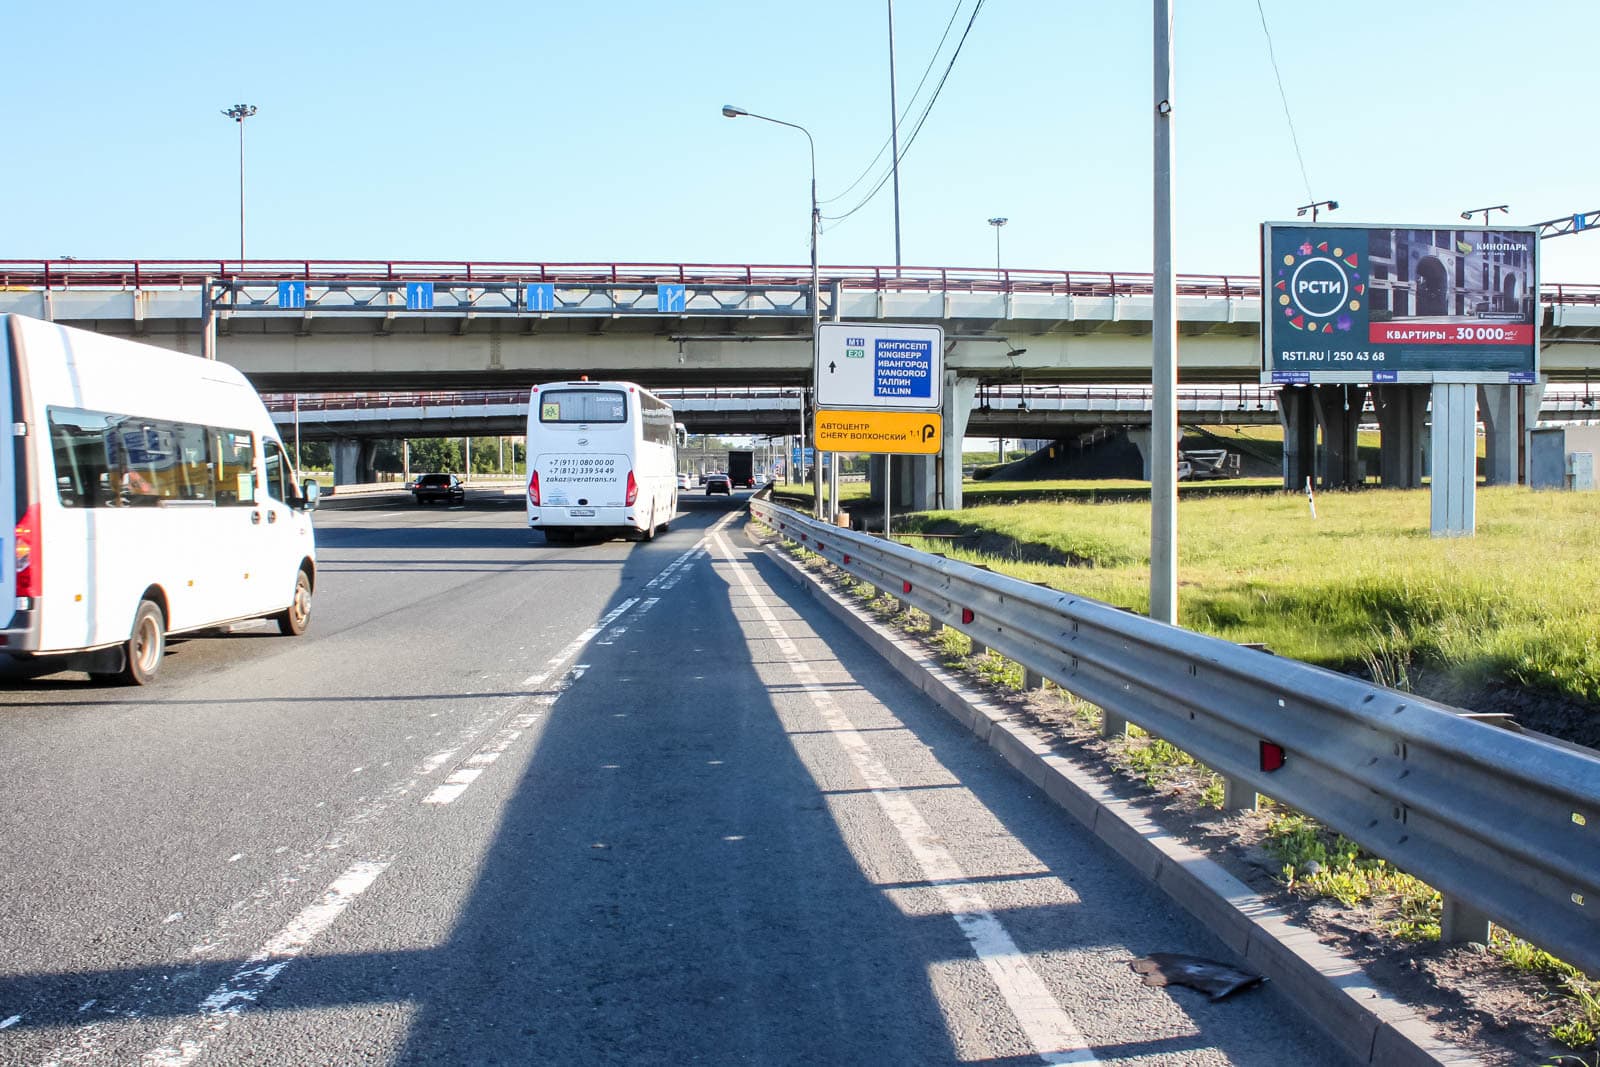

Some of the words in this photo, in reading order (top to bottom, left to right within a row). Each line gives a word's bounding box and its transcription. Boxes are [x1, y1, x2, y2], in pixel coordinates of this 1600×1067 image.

[1476, 243, 1528, 251] КИНОПАРК
[1298, 280, 1341, 294] РСТИ
[1386, 330, 1446, 340] КВАРТИРЫ
[1456, 327, 1474, 340] 30
[1476, 327, 1504, 340] 000
[878, 342, 928, 350] КИНГИСЕПП
[848, 350, 863, 358] E20
[878, 351, 922, 359] KINGISEPP
[1282, 351, 1324, 361] RSTI.RU
[1333, 351, 1354, 361] 250
[1356, 351, 1369, 361] 43
[1372, 351, 1385, 361] 68
[878, 360, 929, 369] ИВАНГОРОД
[877, 369, 927, 377] IVANGOROD
[877, 378, 911, 386] ТАЛЛИН
[877, 387, 912, 395] TALLINN
[820, 423, 870, 431] АВТОЦЕНТР
[850, 432, 907, 441] ВОЛХОНСКИЙ
[560, 459, 578, 467] (911)
[560, 467, 578, 475] (812)
[545, 475, 617, 483] zakaz@veratrans.ru
